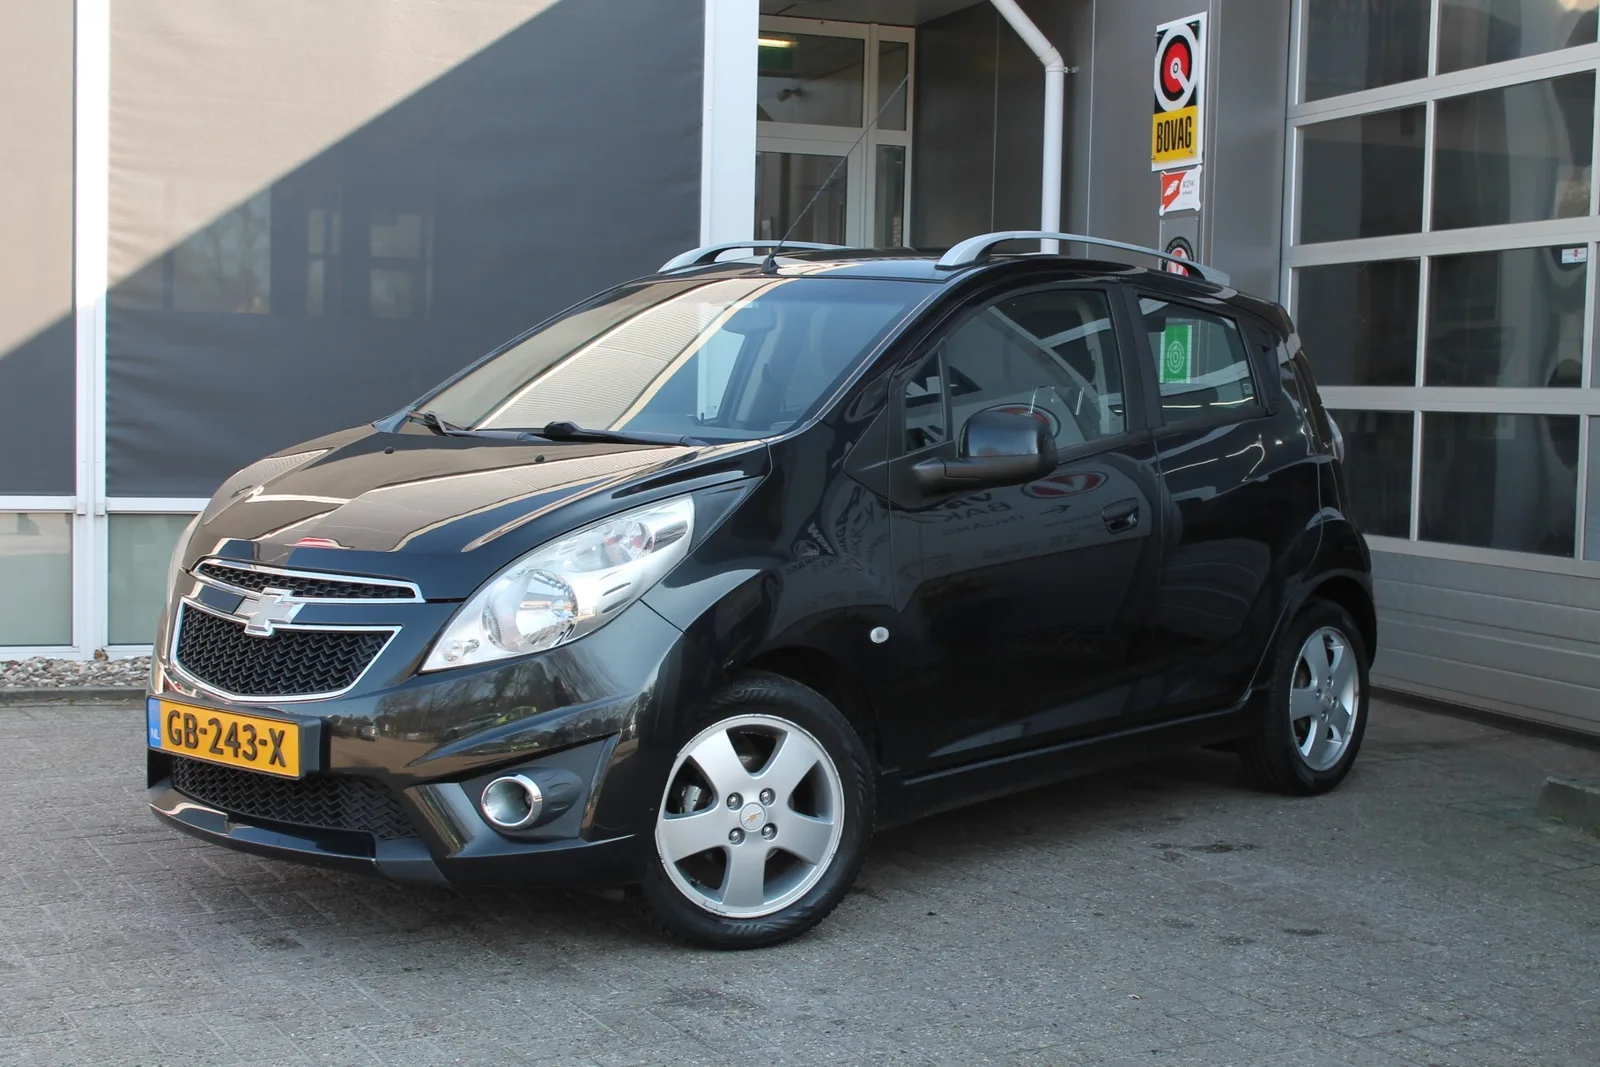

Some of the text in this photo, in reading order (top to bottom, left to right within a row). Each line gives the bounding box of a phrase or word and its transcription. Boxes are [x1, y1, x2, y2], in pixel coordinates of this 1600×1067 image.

[1156, 115, 1192, 153] BOVAG
[150, 727, 160, 740] NL
[166, 709, 287, 768] GB-243-X
